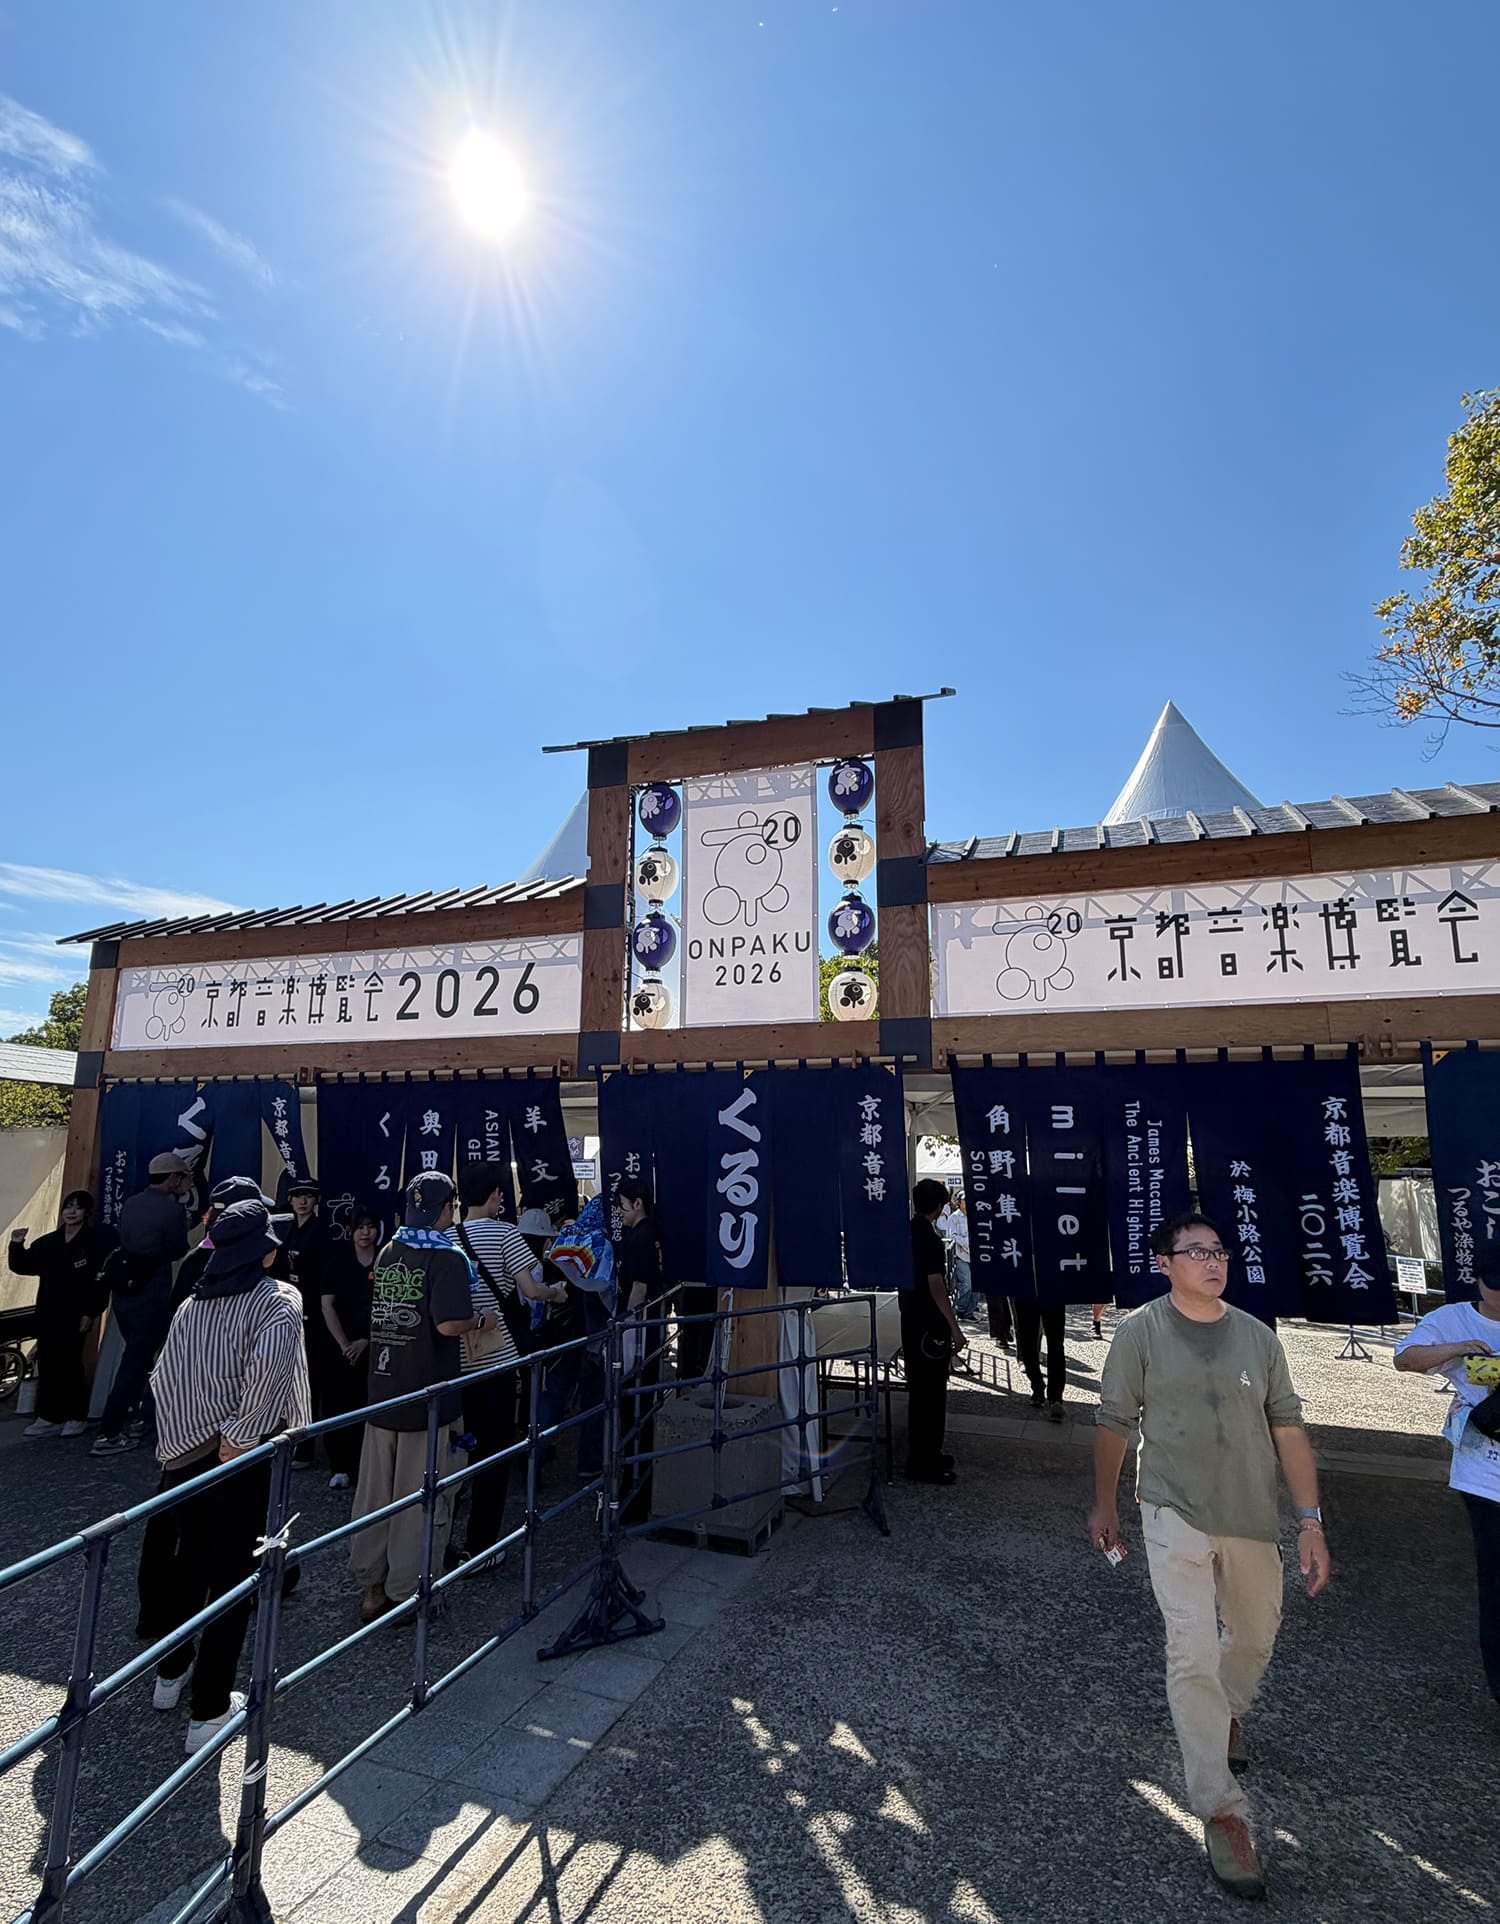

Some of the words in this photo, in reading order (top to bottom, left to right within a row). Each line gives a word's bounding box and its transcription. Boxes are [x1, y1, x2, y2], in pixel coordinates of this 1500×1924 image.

[764, 817, 800, 844] 20
[689, 931, 811, 960] ONPAKU
[1048, 913, 1082, 935] 20
[177, 977, 195, 994] 20
[715, 962, 783, 987] 2026
[485, 1109, 500, 1162] ASIAN
[1125, 1101, 1140, 1127] The
[857, 1094, 886, 1202] 京都音博
[1127, 1135, 1143, 1192] Ancient
[1147, 1120, 1162, 1164] James
[717, 1088, 761, 1269] くるり
[970, 1151, 988, 1192] Solo
[985, 1104, 1022, 1268] 角野隼斗
[1051, 1105, 1087, 1271] milet
[1321, 1096, 1375, 1290] 京都音楽博覧会
[975, 1201, 992, 1212] &
[977, 1220, 994, 1263] Trio
[1127, 1199, 1144, 1274] Highballs
[1447, 1187, 1477, 1285] つるや染物店
